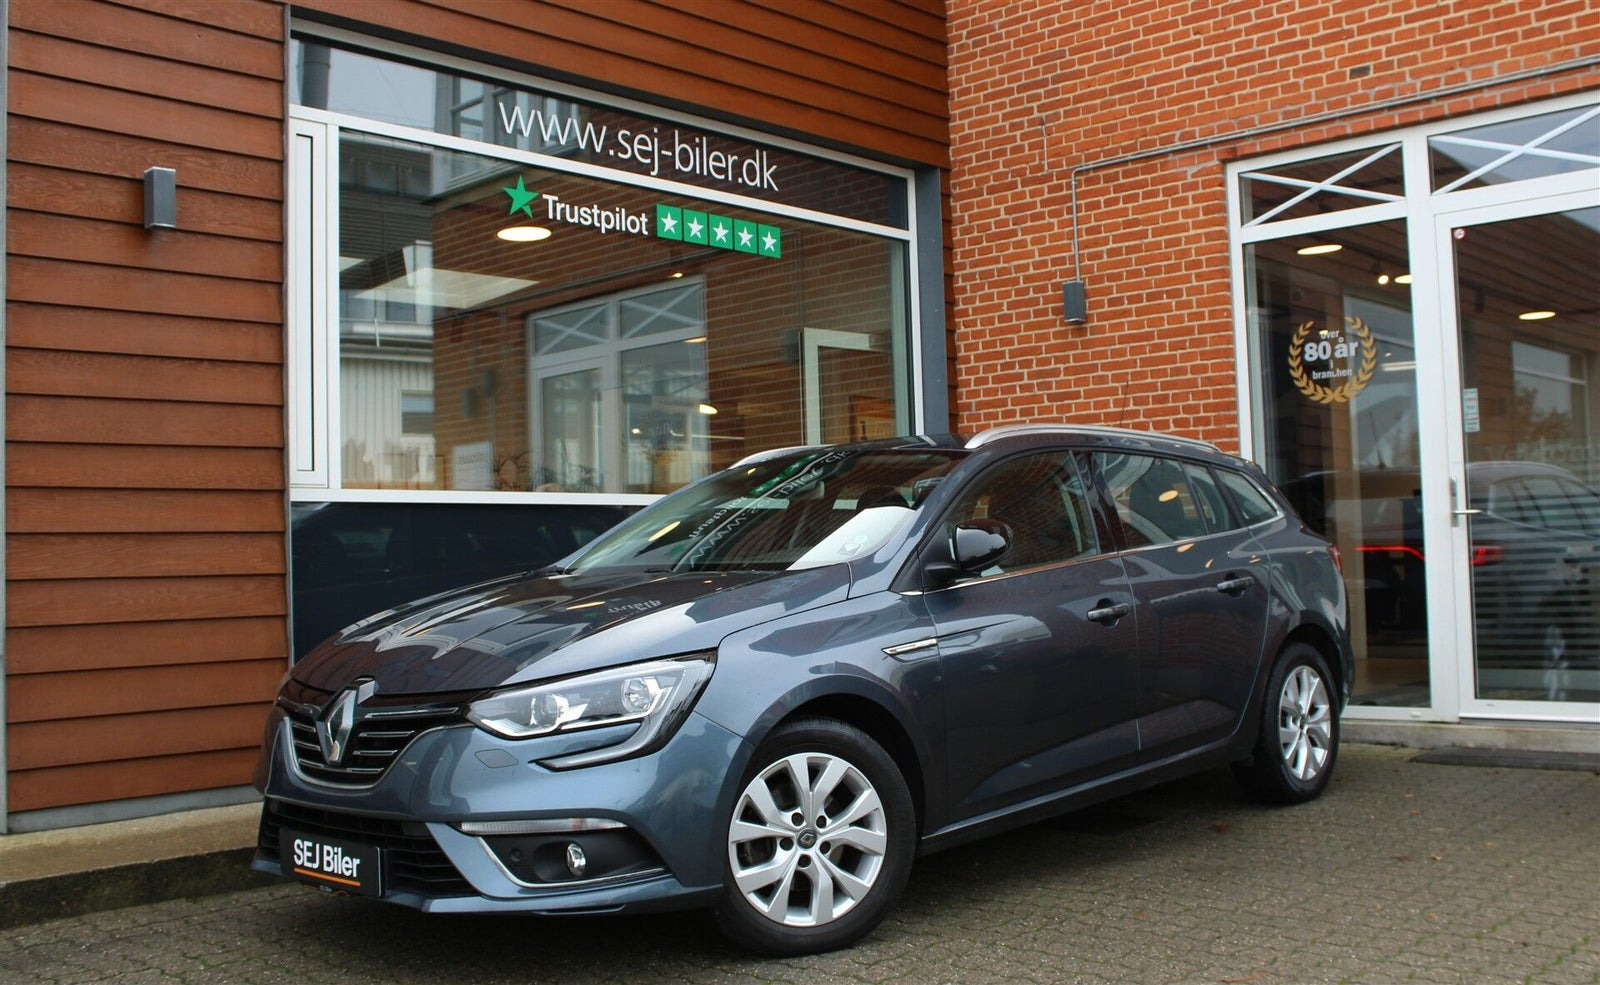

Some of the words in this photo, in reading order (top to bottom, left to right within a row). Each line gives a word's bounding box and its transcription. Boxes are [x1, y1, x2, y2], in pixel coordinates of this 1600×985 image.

[499, 101, 780, 191] www.sej-biler.dk
[542, 193, 648, 235] Trustpilot
[1304, 341, 1332, 362] 80
[1334, 336, 1359, 358] år
[293, 838, 320, 869] SEJ
[323, 844, 361, 878] Biler
